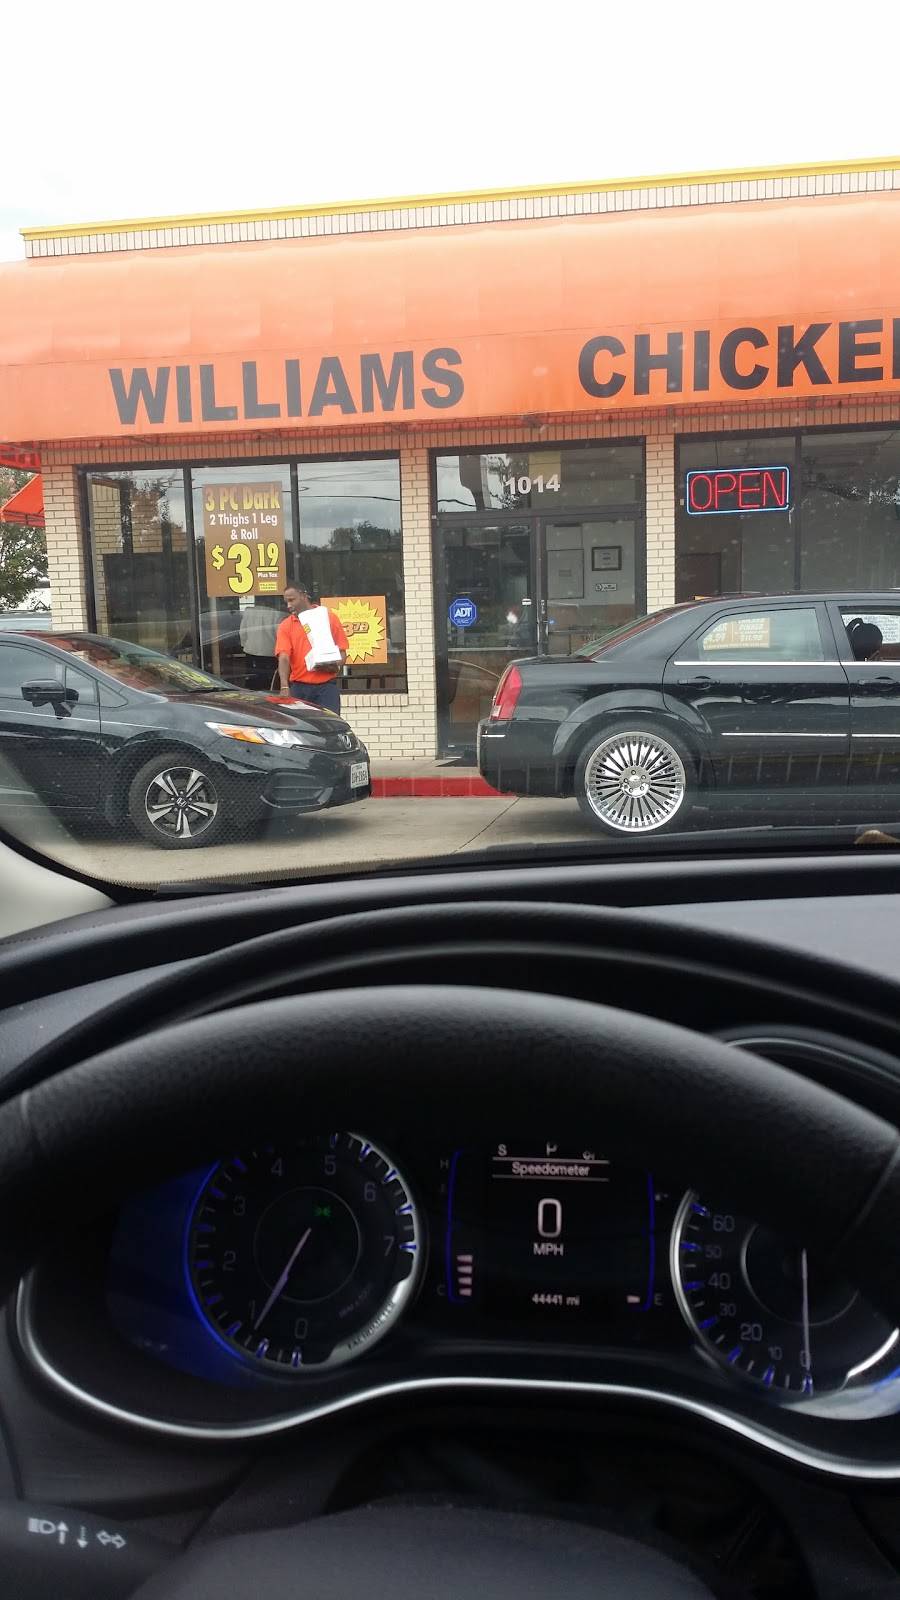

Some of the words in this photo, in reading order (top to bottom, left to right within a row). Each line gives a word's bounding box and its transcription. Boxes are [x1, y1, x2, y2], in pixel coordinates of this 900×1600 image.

[109, 348, 464, 425] WILLIAMS
[578, 318, 900, 398] CHICKE
[505, 474, 560, 495] 1014
[690, 471, 785, 510] OPEN
[205, 487, 215, 511] 3
[220, 487, 238, 511] PC
[243, 484, 280, 510] Dark
[209, 514, 216, 525] 2
[218, 513, 249, 527] Thighs
[261, 512, 278, 526] Leg
[230, 529, 238, 540] &
[241, 528, 258, 540] Roll
[454, 607, 473, 617] ADT
[497, 1144, 508, 1157] S
[271, 1158, 284, 1177] 4
[324, 1154, 337, 1176] 5
[511, 1162, 590, 1177] Speedometer
[364, 1181, 377, 1202] 6
[233, 1195, 246, 1216] 3
[537, 1198, 562, 1238] 0
[712, 1215, 736, 1233] 60
[384, 1235, 395, 1256] 7
[533, 1243, 564, 1256] MPH
[705, 1245, 722, 1259] 50
[222, 1250, 237, 1271] 2
[708, 1272, 731, 1290] 40
[532, 1294, 563, 1305] 44441
[566, 1295, 580, 1306] mi
[719, 1303, 736, 1318] 30
[295, 1317, 309, 1340] 0
[740, 1323, 763, 1342] 20
[768, 1346, 782, 1361] 10
